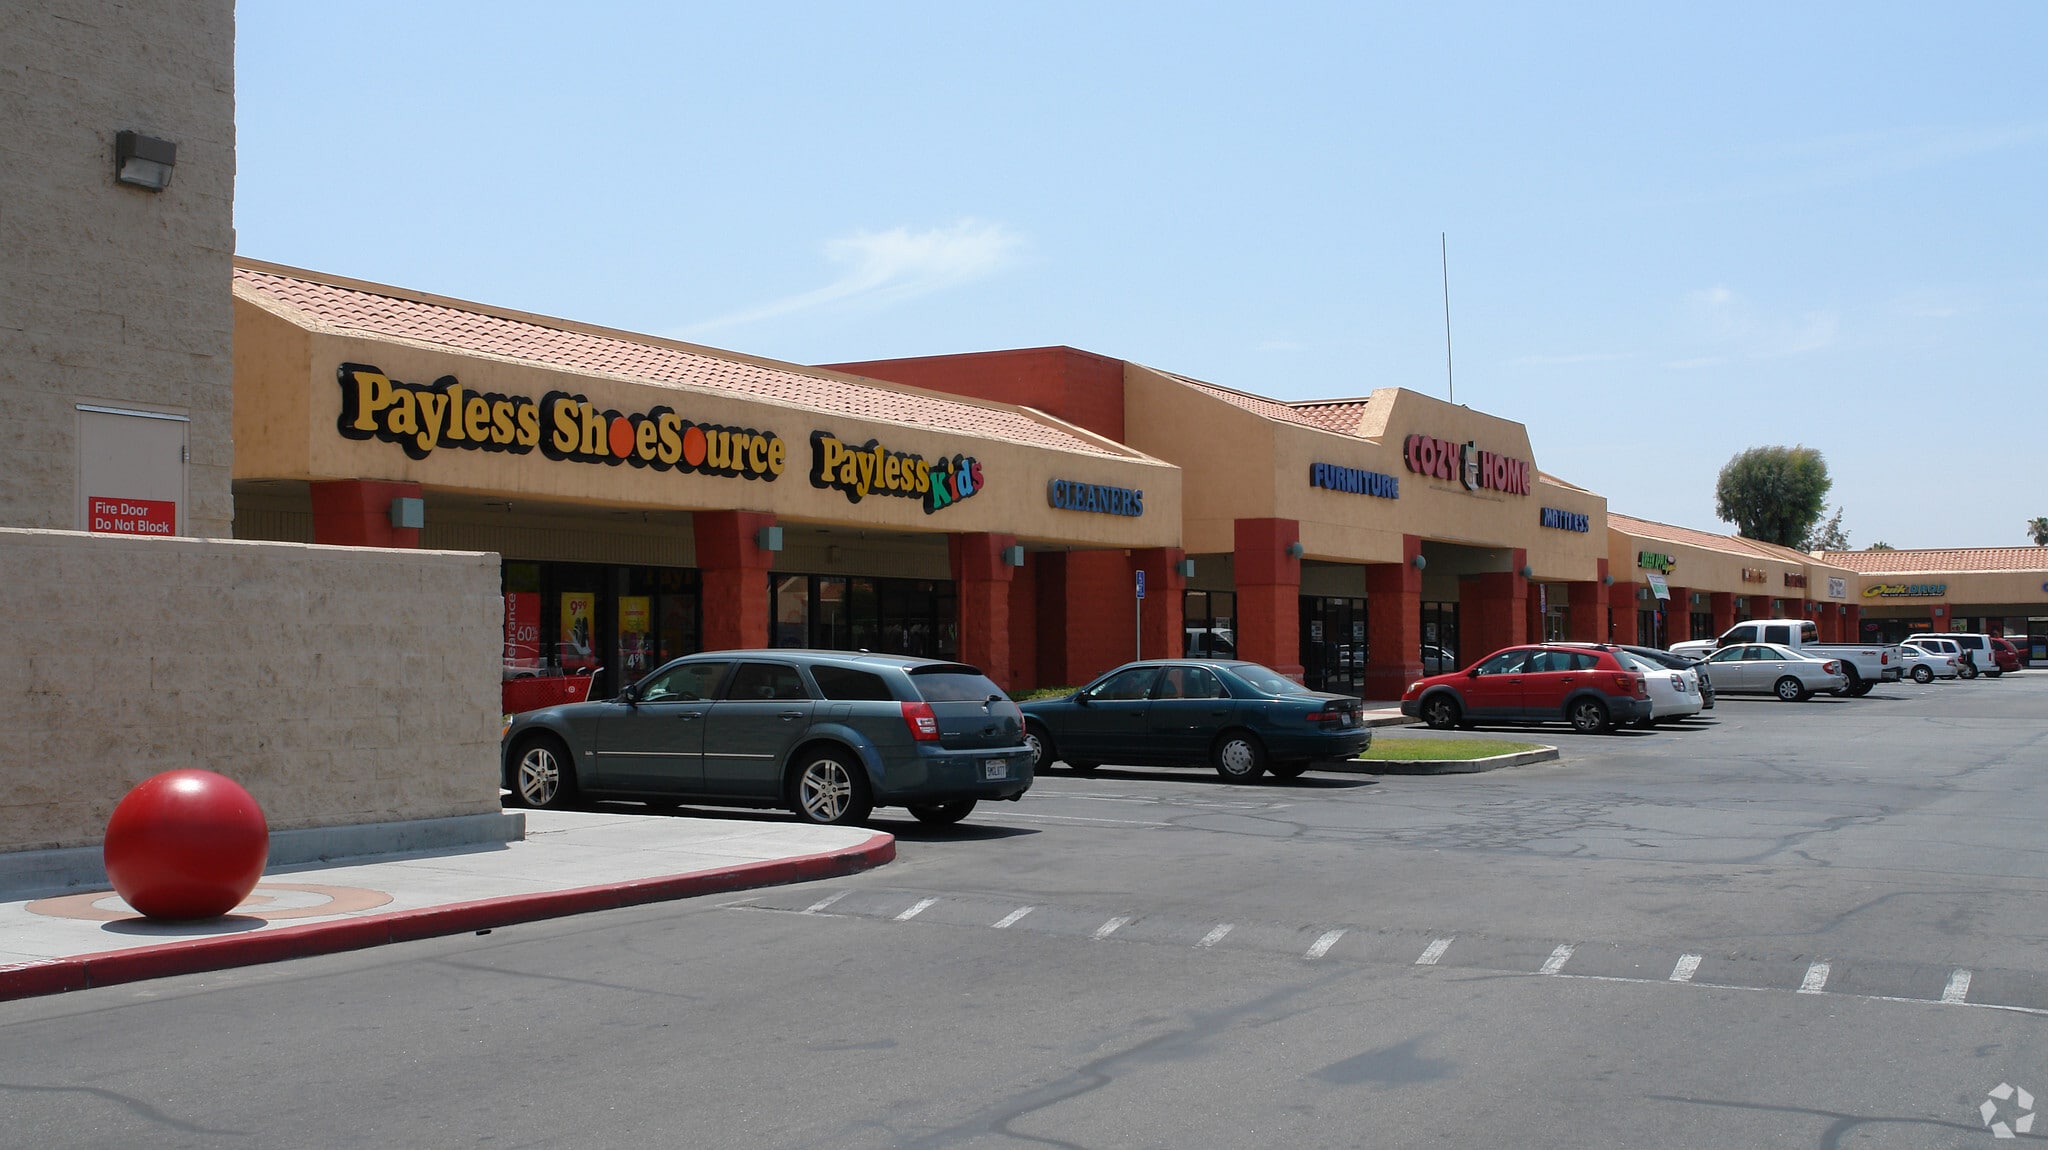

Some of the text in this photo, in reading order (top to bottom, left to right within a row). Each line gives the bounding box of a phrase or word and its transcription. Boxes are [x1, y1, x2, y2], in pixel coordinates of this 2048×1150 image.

[352, 371, 785, 475] Payless ShoeSource
[821, 437, 984, 509] Payless Kids
[1311, 462, 1399, 500] FURNITURE
[1404, 434, 1531, 496] COZY HOME
[95, 502, 149, 516] Fire Door
[1052, 479, 1144, 517] CLEANERS
[95, 518, 170, 533] Do Not Block
[1909, 583, 1947, 594] DROP
